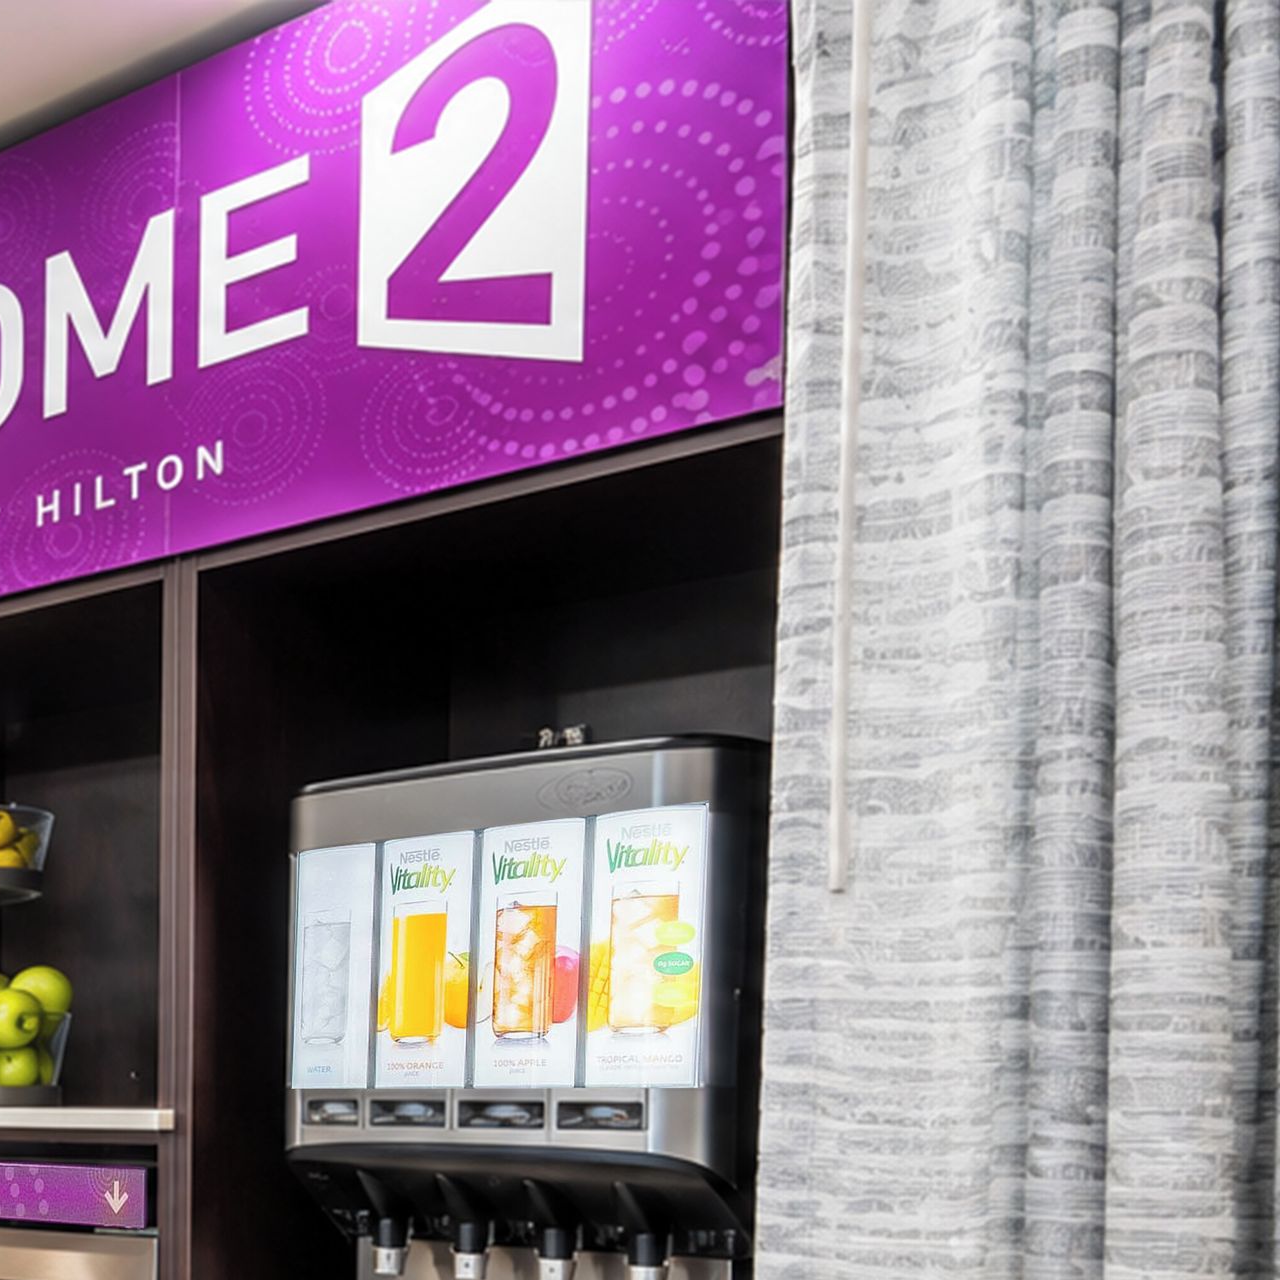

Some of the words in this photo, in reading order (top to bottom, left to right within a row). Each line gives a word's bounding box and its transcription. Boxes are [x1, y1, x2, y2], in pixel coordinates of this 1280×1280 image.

[385, 22, 559, 327] 2
[35, 440, 227, 528] HILTON
[492, 850, 567, 885] Vitality
[606, 837, 690, 874] Vitality
[390, 862, 457, 896] Vitality
[405, 1062, 444, 1070] ORANGE
